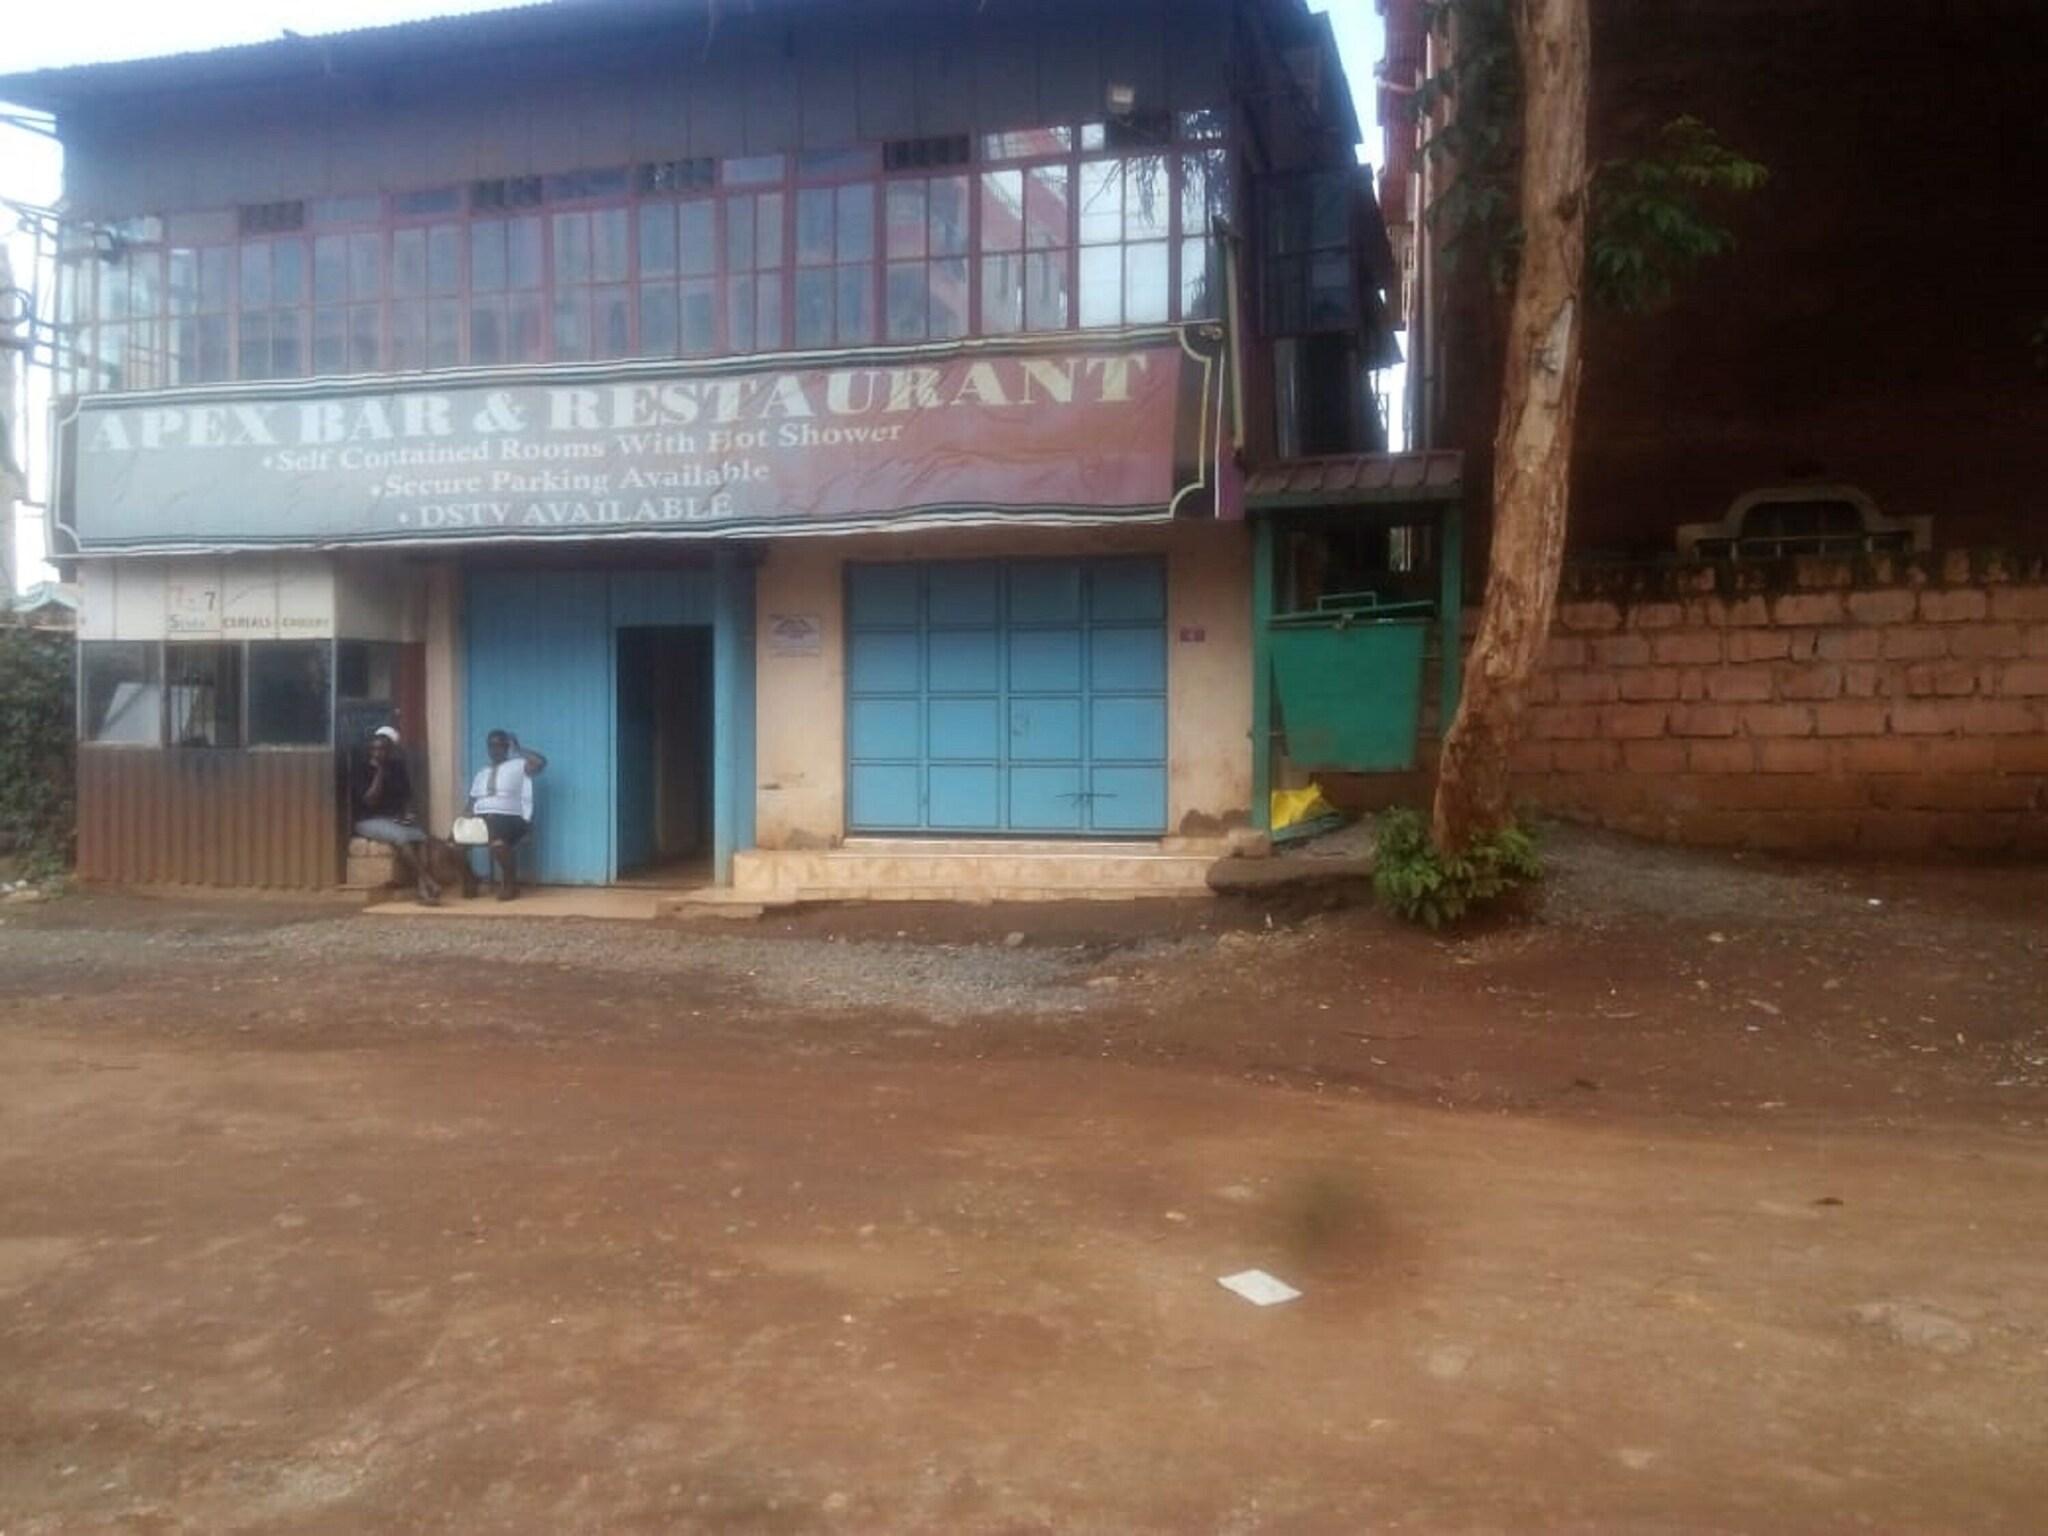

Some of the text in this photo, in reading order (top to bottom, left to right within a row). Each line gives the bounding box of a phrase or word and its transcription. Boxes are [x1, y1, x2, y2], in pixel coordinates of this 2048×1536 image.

[88, 352, 1149, 452] APEX BAR & RESTAURANT
[277, 422, 904, 472] Self Contained Rooms With Hot Shower
[385, 458, 771, 498] Secure Parking Available
[420, 491, 734, 528] DSTV AVAILABLE
